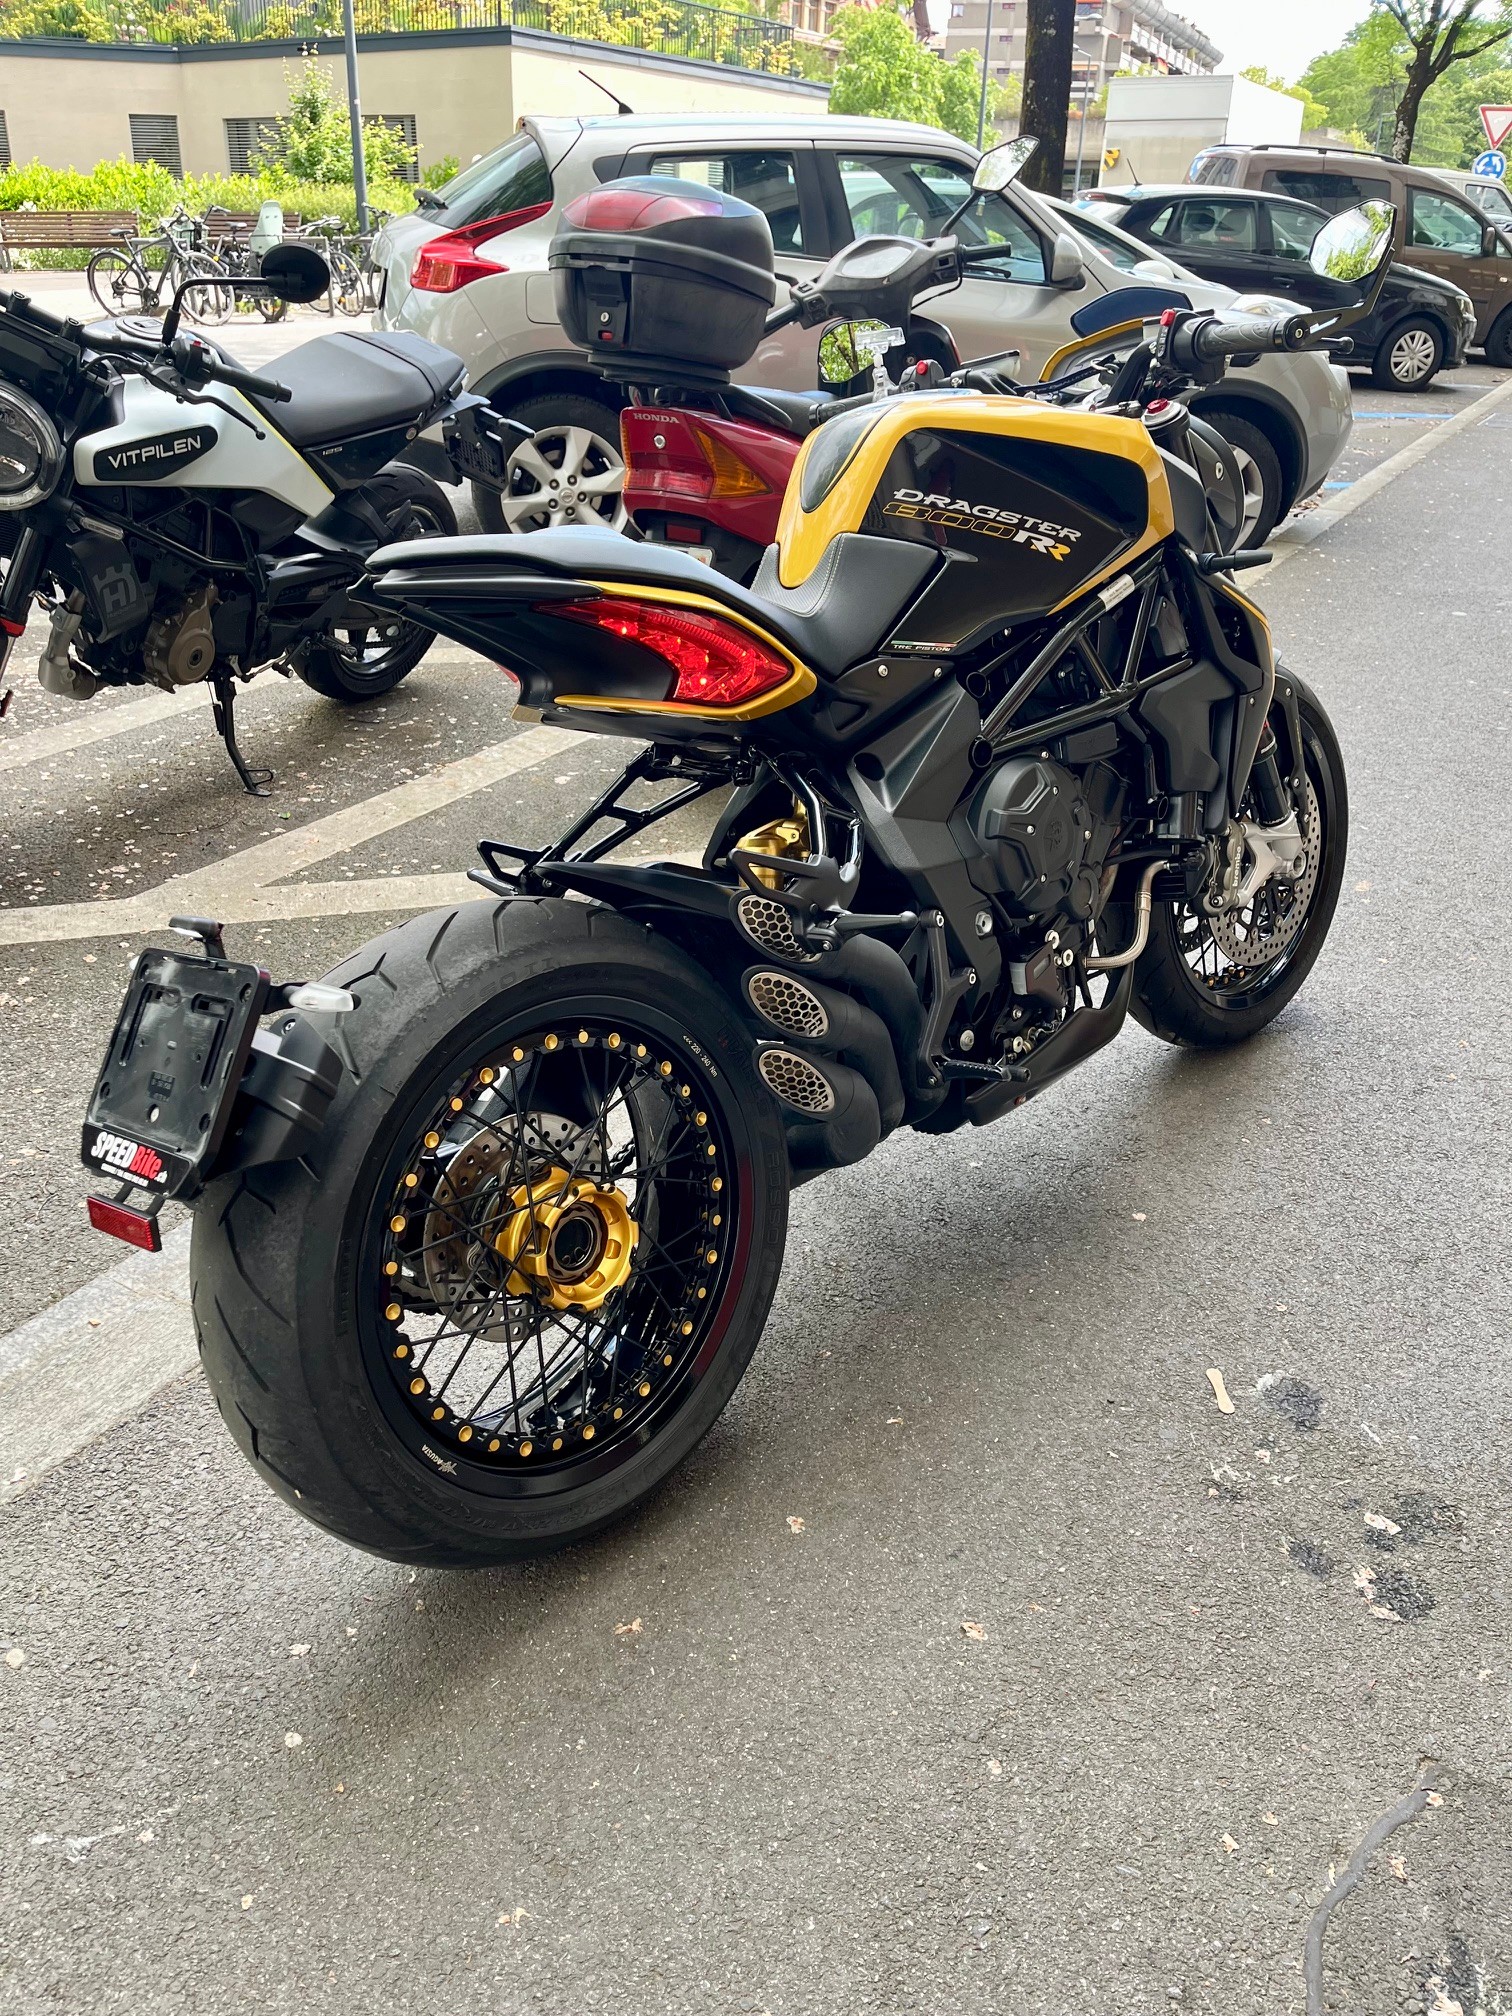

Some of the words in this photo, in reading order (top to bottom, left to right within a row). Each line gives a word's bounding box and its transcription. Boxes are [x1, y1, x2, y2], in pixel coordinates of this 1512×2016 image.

[633, 412, 680, 424] HONDA
[108, 435, 201, 469] VITPILEN
[893, 488, 1082, 542] DRAGSTER
[1232, 846, 1242, 887] brembo
[421, 1444, 444, 1465] AGUSTA
